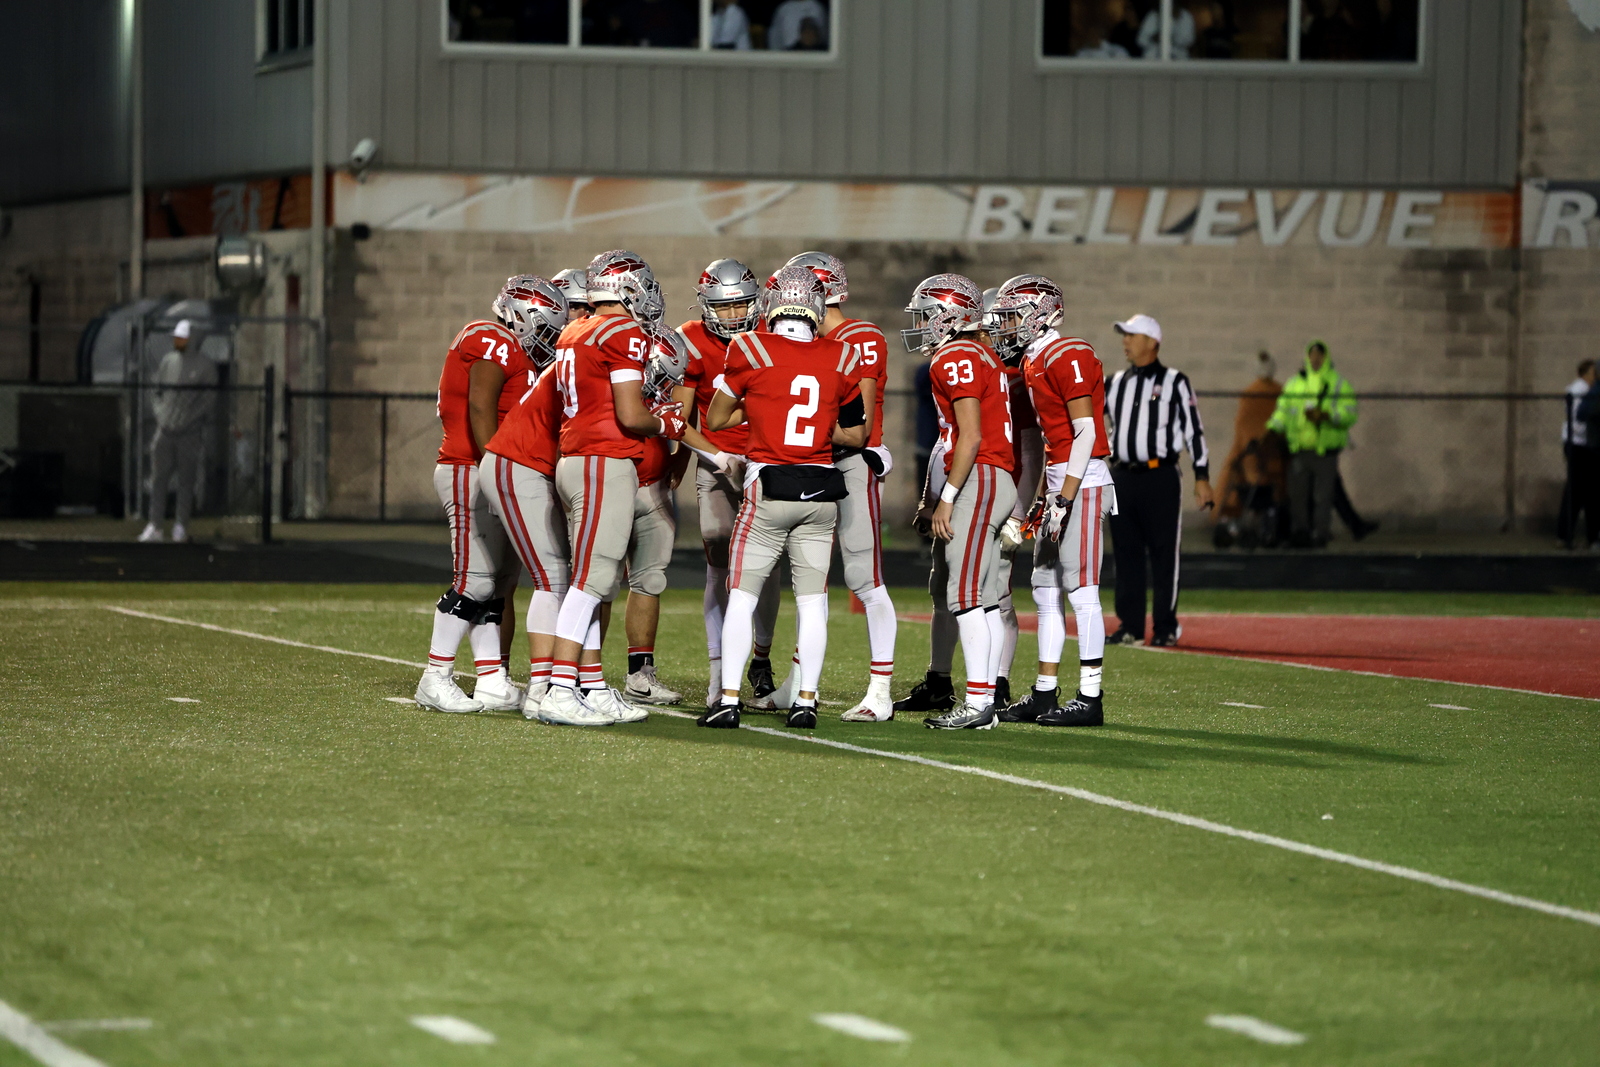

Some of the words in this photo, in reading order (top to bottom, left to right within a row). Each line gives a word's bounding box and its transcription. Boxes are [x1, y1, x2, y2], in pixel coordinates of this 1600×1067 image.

[967, 188, 1442, 246] BELLEVUE
[783, 306, 807, 315] schutt
[481, 336, 509, 366] 74
[853, 340, 878, 366] 15
[943, 359, 974, 386] 33
[1070, 359, 1084, 384] 1
[783, 374, 820, 447] 2
